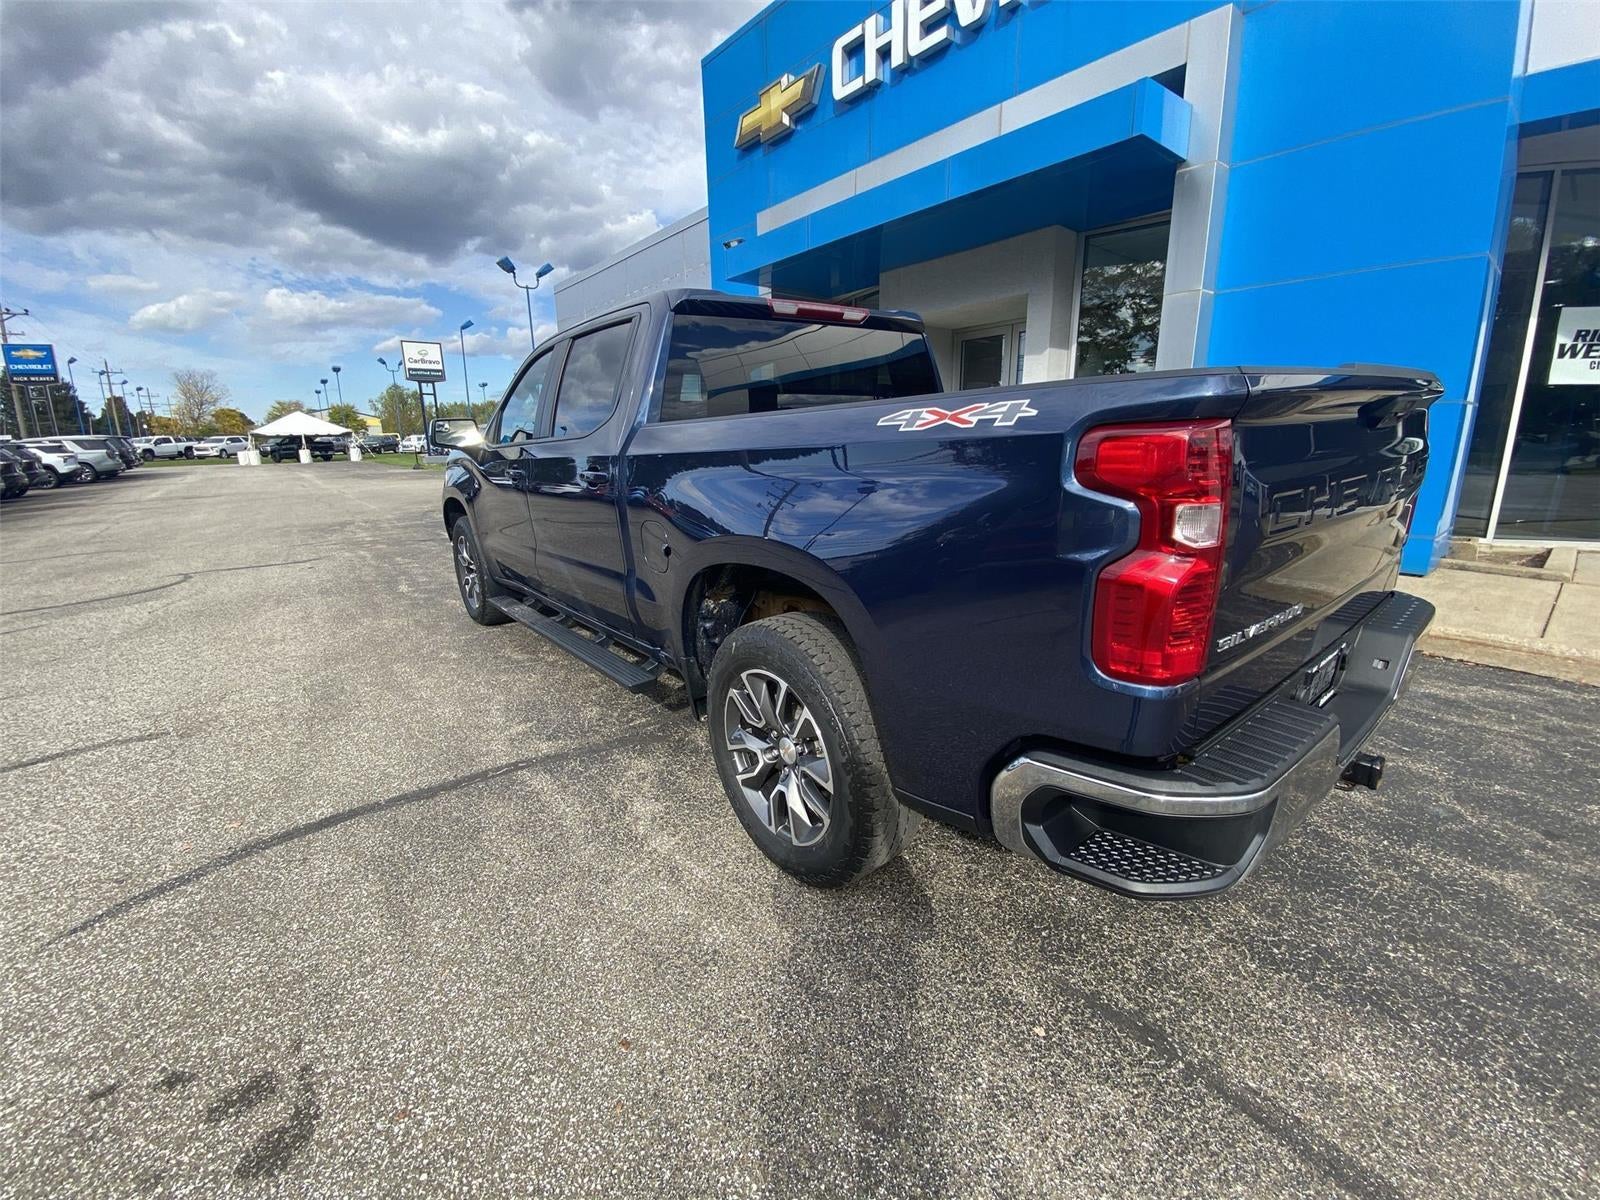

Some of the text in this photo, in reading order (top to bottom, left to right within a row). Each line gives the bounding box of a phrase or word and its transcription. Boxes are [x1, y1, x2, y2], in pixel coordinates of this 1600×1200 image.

[1572, 329, 1600, 343] RI
[408, 357, 440, 365] CarBravo
[1216, 603, 1304, 653] SILVERADO
